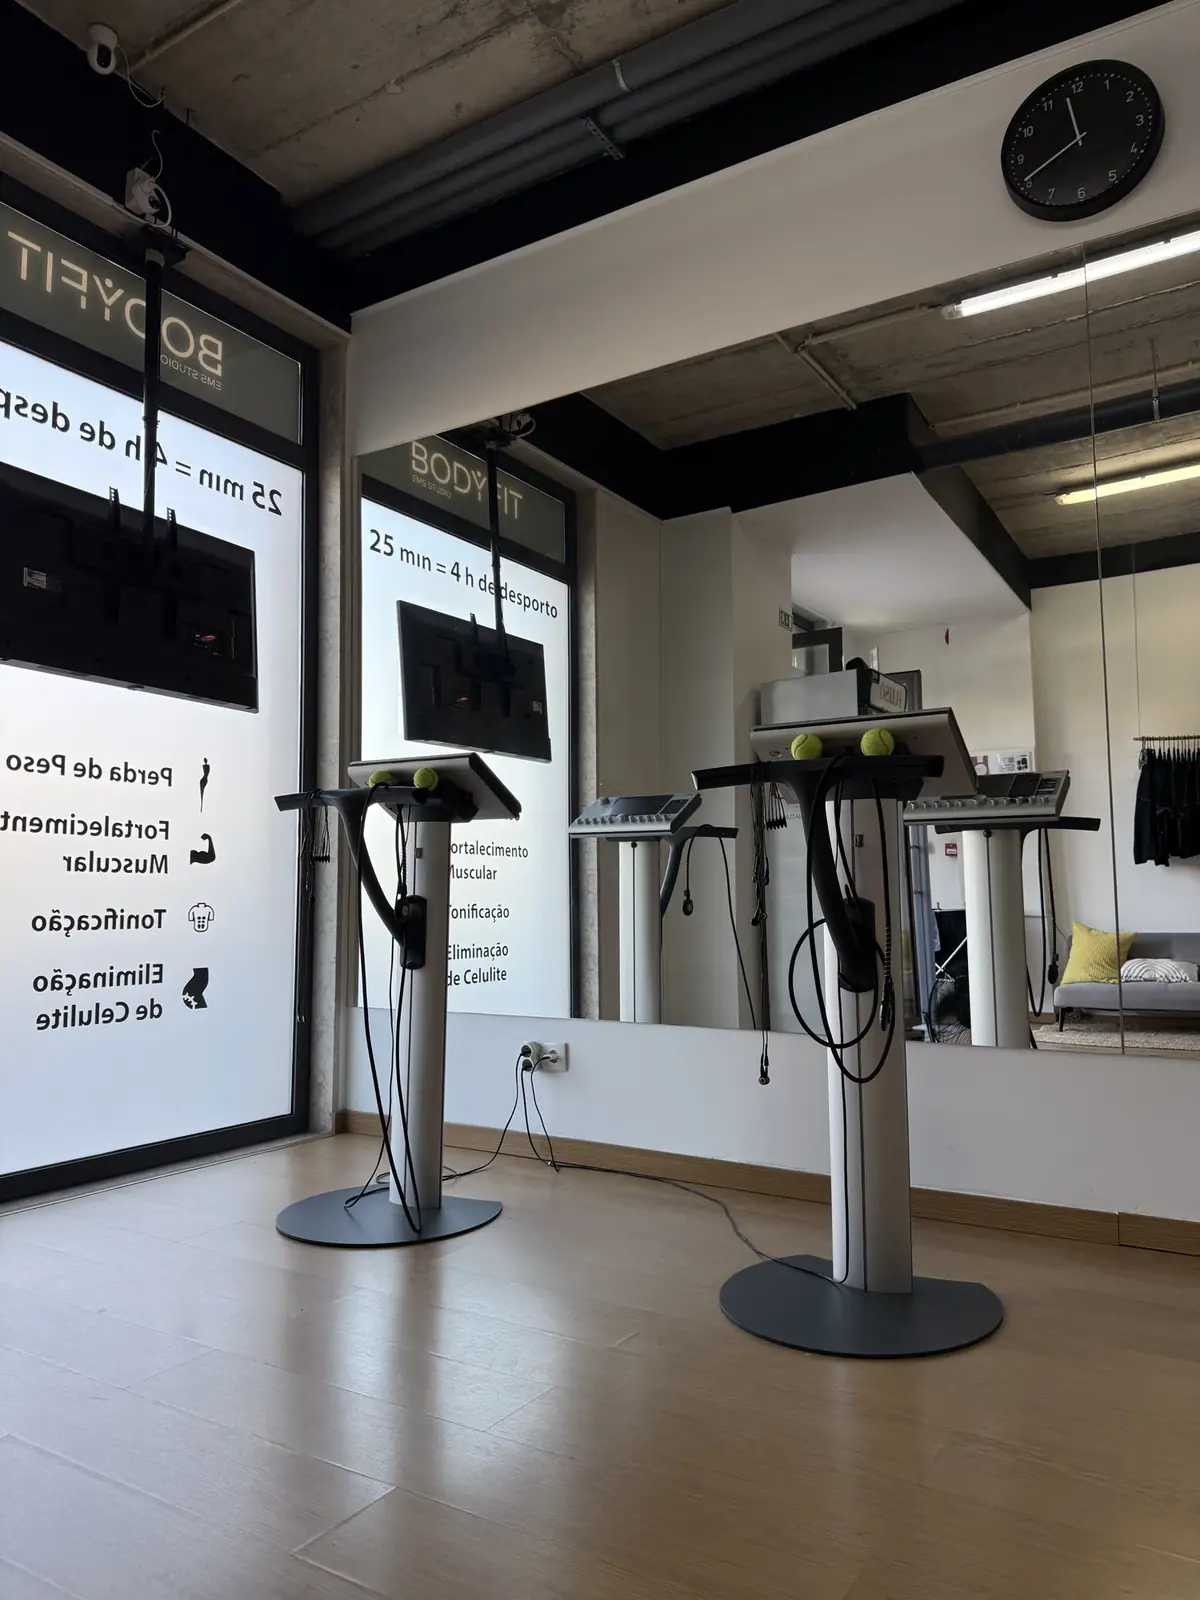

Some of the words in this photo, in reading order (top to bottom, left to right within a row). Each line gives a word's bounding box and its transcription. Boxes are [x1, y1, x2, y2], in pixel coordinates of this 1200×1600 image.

[1071, 81, 1084, 94] 12
[1104, 79, 1110, 90] 1
[1126, 91, 1134, 102] 2
[1042, 100, 1053, 112] 11
[1136, 114, 1144, 126] 3
[1022, 126, 1034, 138] 10
[1130, 143, 1137, 154] 4
[1017, 154, 1024, 165] 9
[1108, 170, 1117, 182] 5
[1048, 188, 1056, 199] 7
[1078, 187, 1086, 199] 6
[370, 529, 394, 557] 25
[400, 546, 431, 571] min
[450, 561, 461, 582] 4
[466, 566, 474, 587] h
[478, 574, 495, 595] de
[500, 582, 558, 618] desporto
[450, 840, 529, 858] ortalecimento
[449, 904, 510, 923] onificação
[464, 967, 507, 985] Celulite
